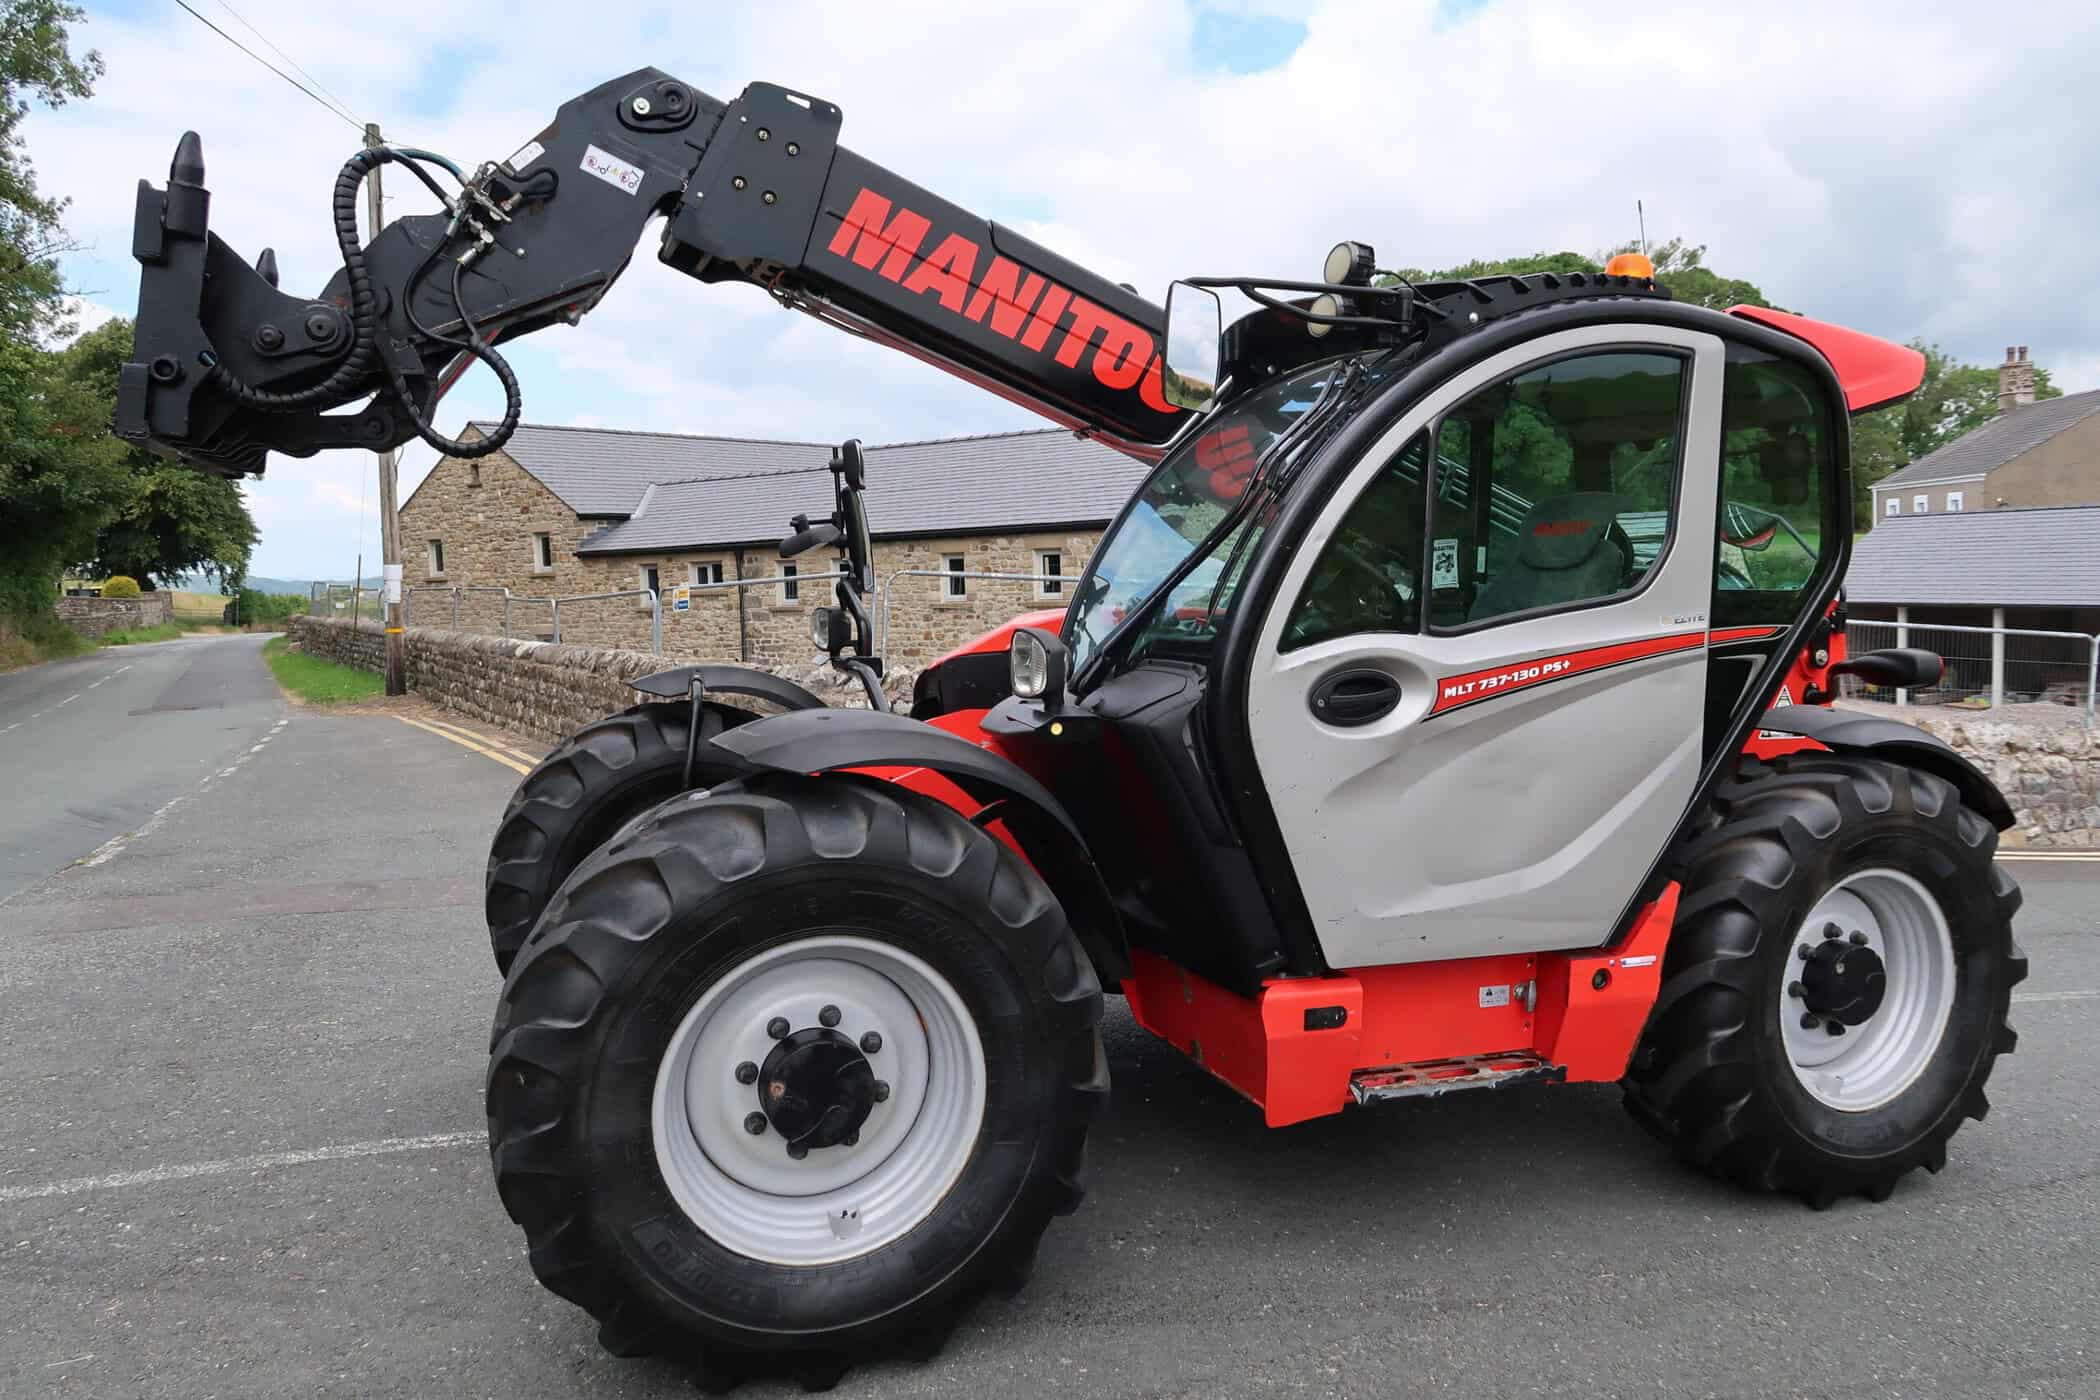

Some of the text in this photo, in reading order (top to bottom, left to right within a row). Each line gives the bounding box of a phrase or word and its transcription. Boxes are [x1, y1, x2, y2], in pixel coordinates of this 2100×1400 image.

[1444, 660, 1571, 699] MLT 737-130 PS+
